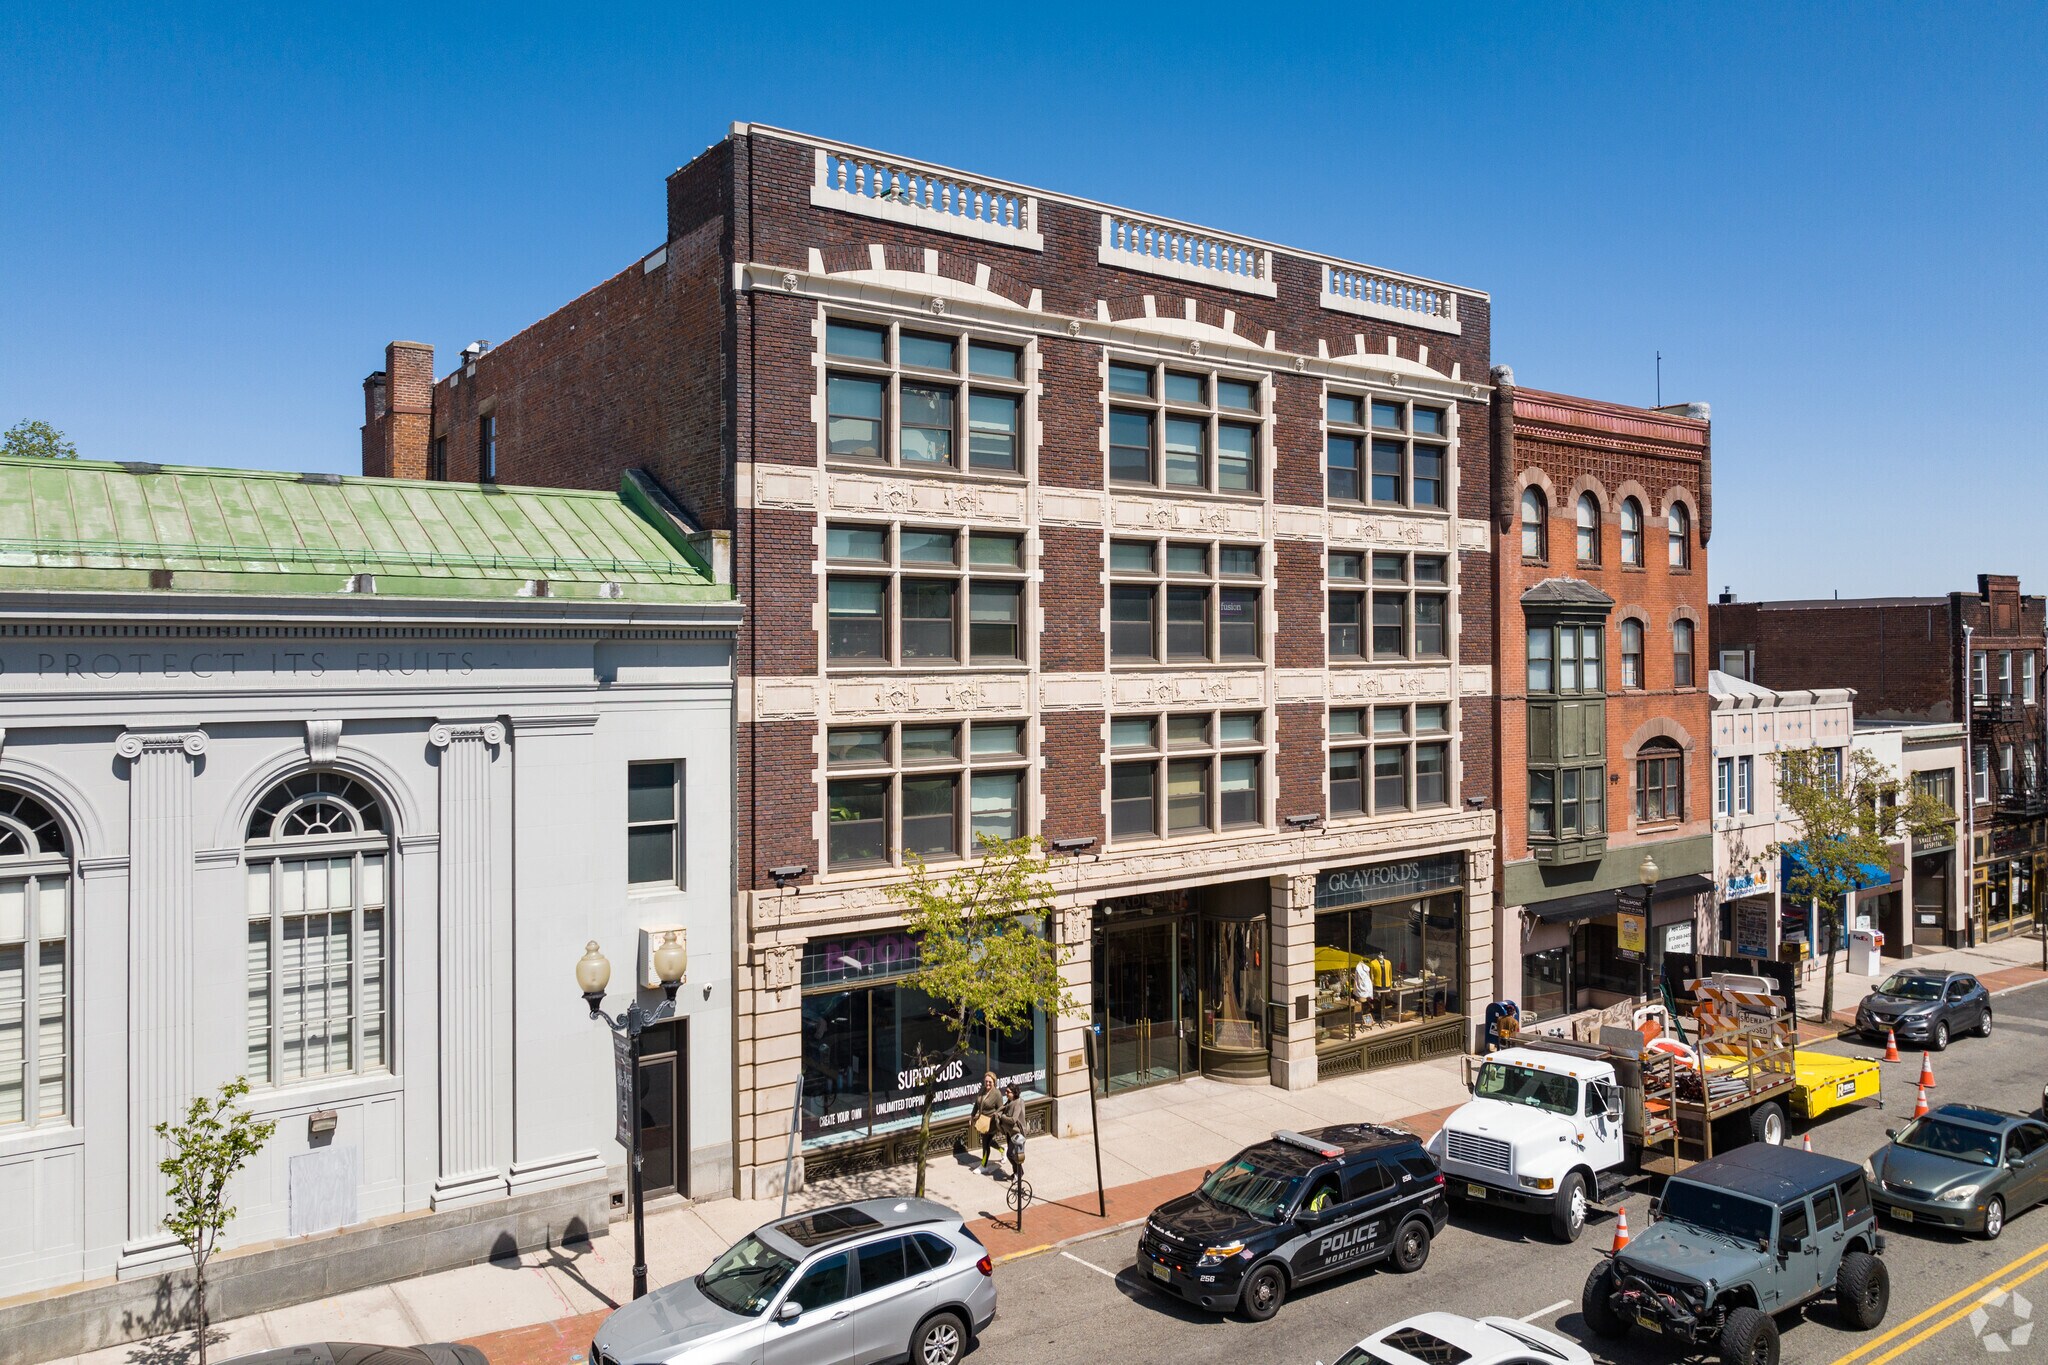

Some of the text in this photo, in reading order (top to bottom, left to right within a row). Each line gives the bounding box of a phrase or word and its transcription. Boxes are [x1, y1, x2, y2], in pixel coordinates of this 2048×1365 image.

[1220, 601, 1242, 611] fusion
[37, 652, 474, 680] PROTECT ITS FRUITS
[1328, 862, 1420, 891] GRAYFORD'S
[1740, 1015, 1768, 1025] SIDEWAL
[1744, 1025, 1768, 1035] OSED
[876, 1098, 905, 1115] UNLIMITED
[905, 1095, 926, 1109] TOPPIN
[943, 1082, 982, 1101] COMBINATIONS
[819, 1108, 863, 1127] CREATE YOUR OWN
[1319, 1221, 1380, 1257] POLICE
[1325, 1242, 1375, 1265] MONTCLAIR
[1200, 1274, 1216, 1283] 256
